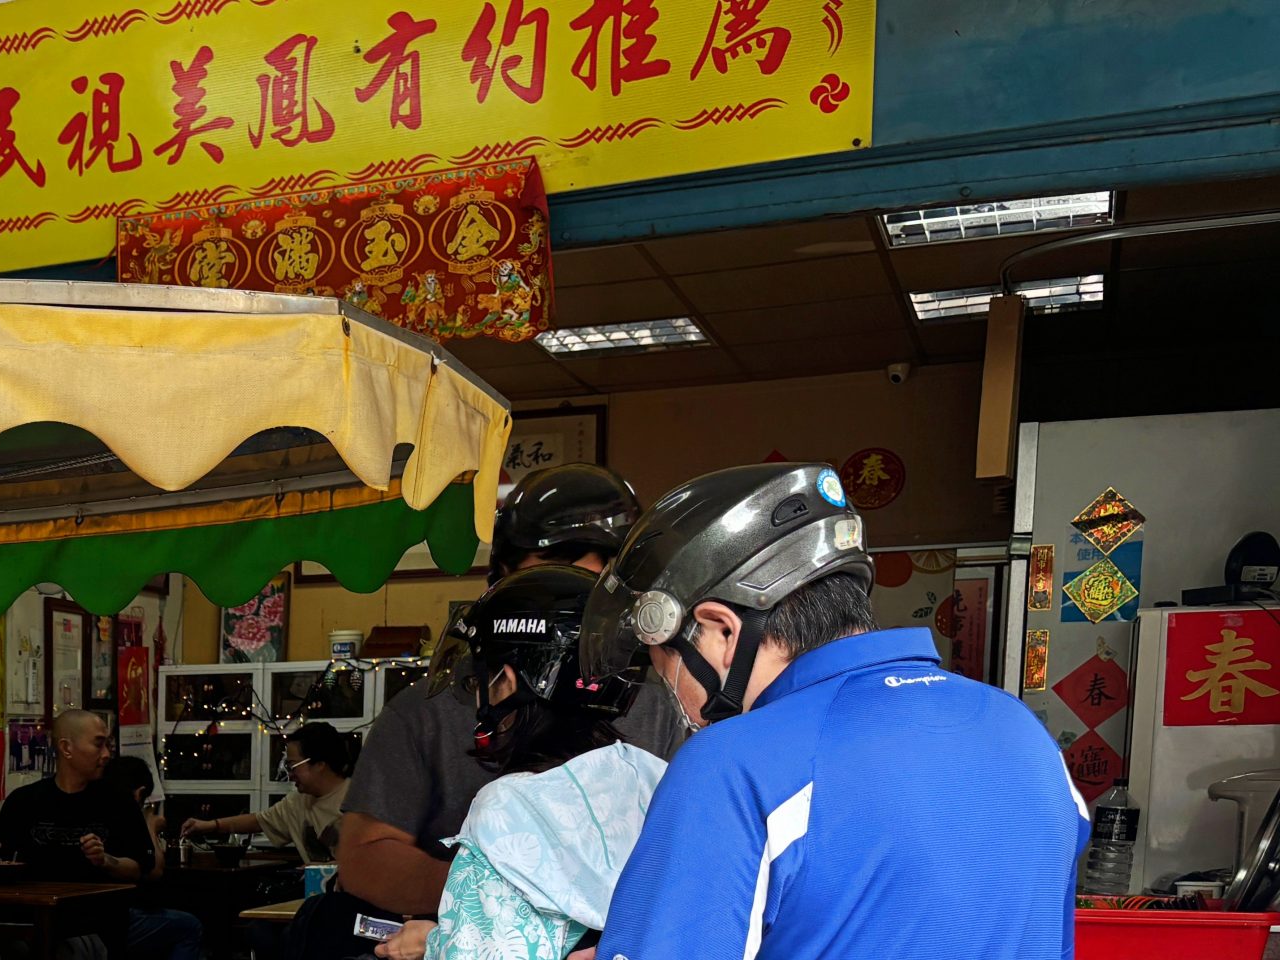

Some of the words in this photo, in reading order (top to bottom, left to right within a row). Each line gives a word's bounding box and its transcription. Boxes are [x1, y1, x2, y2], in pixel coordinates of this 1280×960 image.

[856, 453, 891, 486] 春
[492, 617, 547, 635] YAMAHA
[884, 672, 947, 687] Champion
[1180, 629, 1280, 714] 春
[1083, 673, 1116, 706] 春
